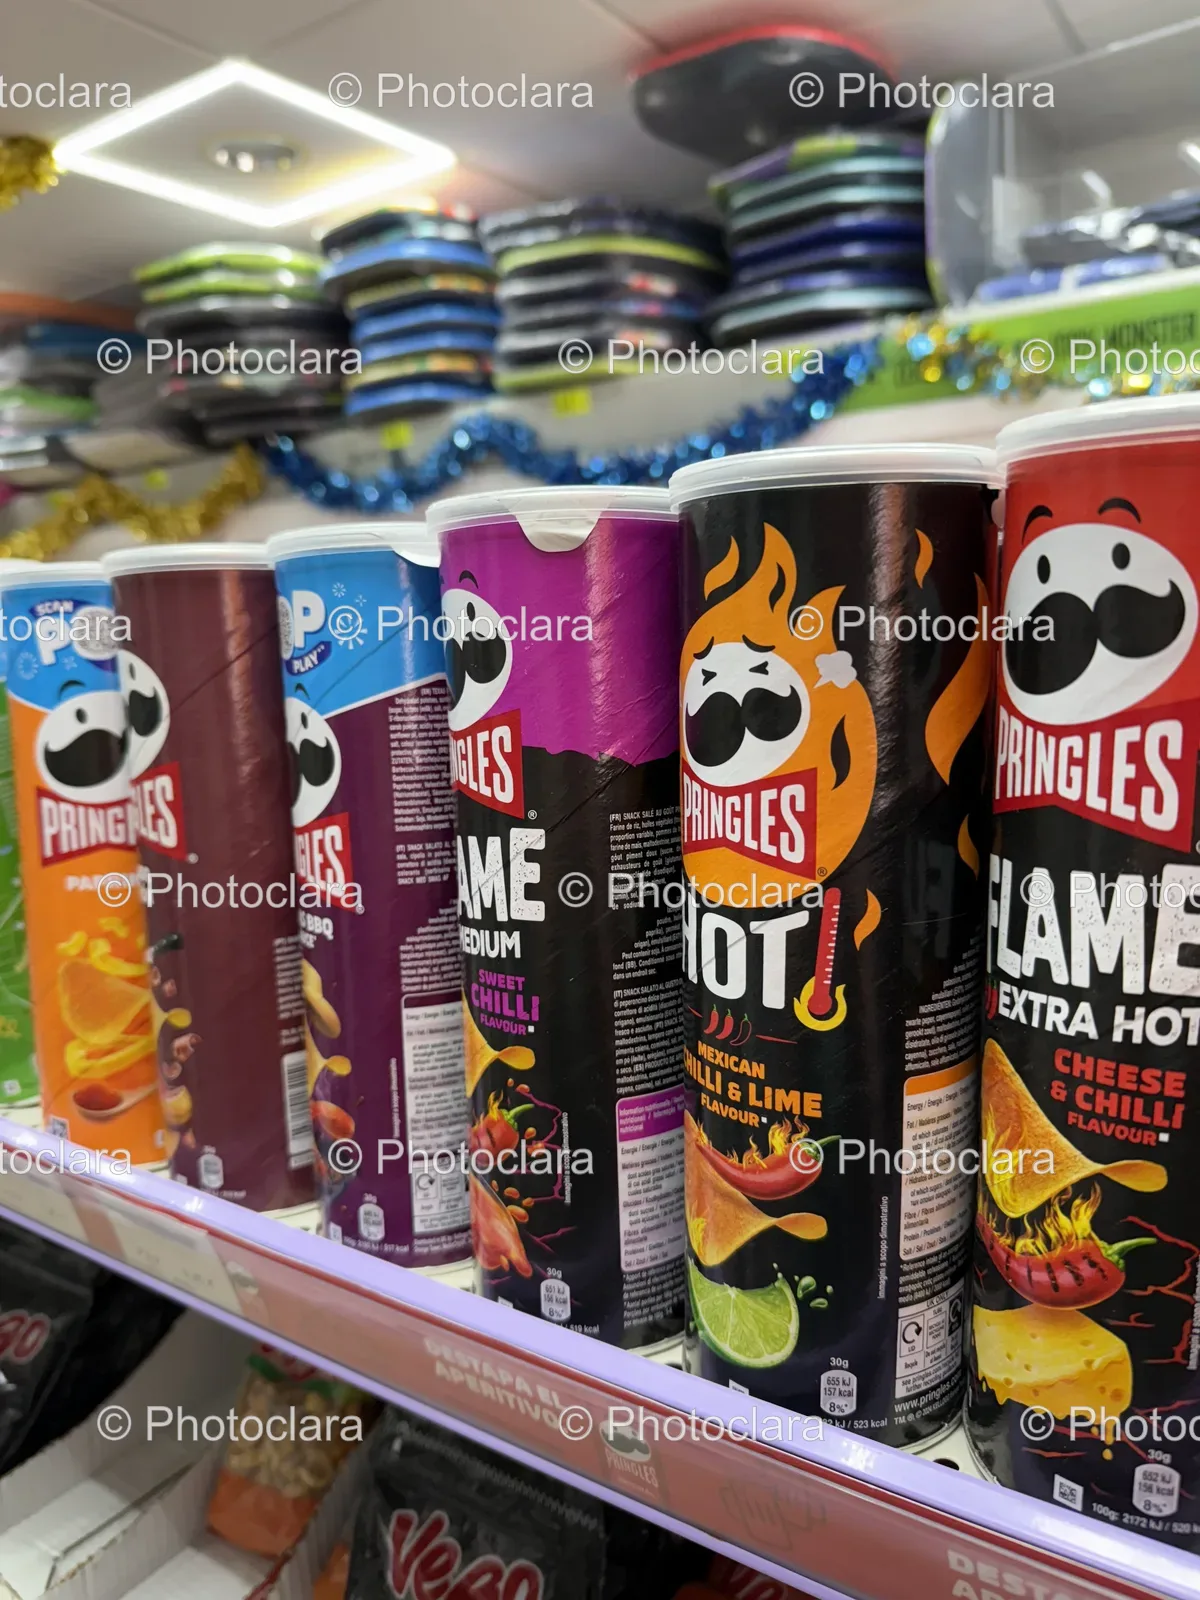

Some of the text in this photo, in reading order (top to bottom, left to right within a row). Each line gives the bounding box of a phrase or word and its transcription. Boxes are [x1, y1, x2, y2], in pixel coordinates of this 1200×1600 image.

[450, 726, 514, 803] NGLES
[995, 704, 1183, 831] PRINGLES
[623, 811, 640, 820] SNACK
[683, 772, 805, 864] PRINGLES
[457, 828, 546, 922] AME
[988, 854, 1200, 996] FLAME
[478, 968, 525, 991] SWEET
[471, 983, 540, 1022] CHILLI
[998, 981, 1098, 1040] EXTRA
[1112, 1004, 1200, 1047] HOT
[480, 1014, 526, 1035] FLAVOUR
[698, 1040, 765, 1079] MEXICAN
[1054, 1048, 1187, 1098] CHEESE
[701, 1092, 759, 1128] FLAVOUR
[728, 1082, 742, 1102] &
[749, 1082, 822, 1118] LIME
[1050, 1080, 1186, 1129] & CHILLI
[1068, 1111, 1157, 1146] FLAVOUR
[546, 1266, 562, 1279] 30g
[424, 1335, 562, 1411] DESTAPA EL
[830, 1356, 848, 1368] 30g
[436, 1360, 560, 1430] APERITIVO
[824, 1387, 854, 1398] 157 kcal
[826, 1376, 851, 1386] 655 kJ
[854, 1420, 869, 1429] 523
[870, 1418, 888, 1428] kcal
[1148, 1449, 1172, 1464] 30g
